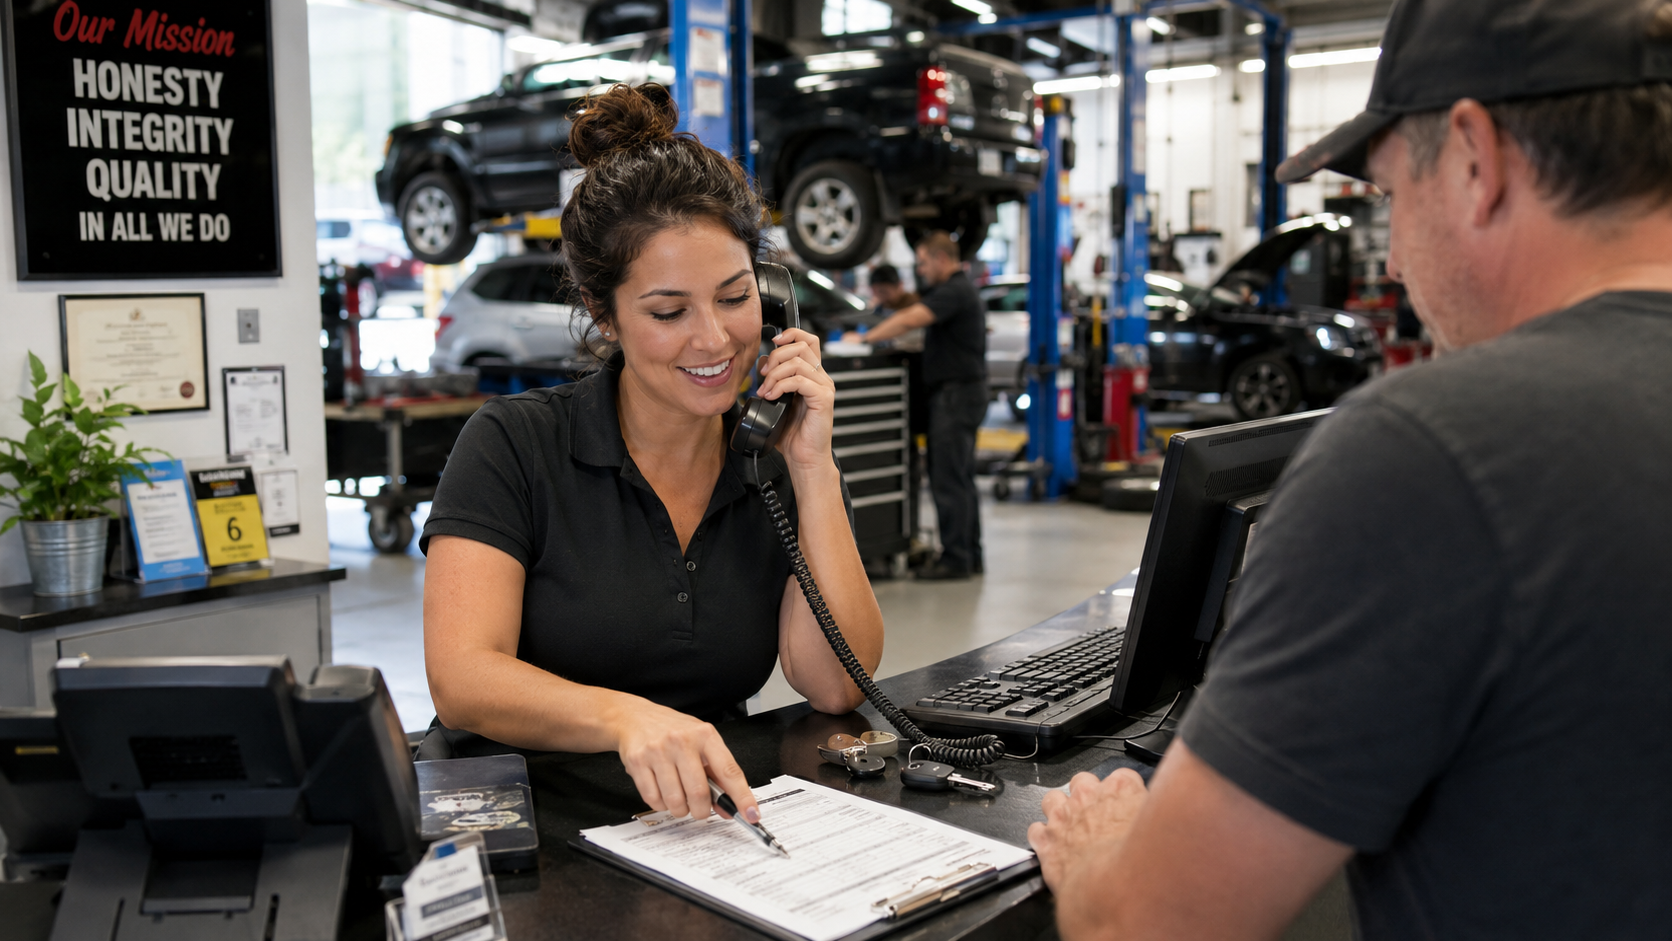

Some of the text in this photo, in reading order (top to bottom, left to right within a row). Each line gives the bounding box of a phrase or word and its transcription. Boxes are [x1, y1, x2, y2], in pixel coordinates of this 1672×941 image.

[53, 0, 235, 57] Our Mission
[73, 58, 223, 109] HONESTY
[66, 107, 234, 155] INTEGRITY
[86, 158, 221, 202] QUALITY
[79, 211, 230, 242] IN ALL WE DO
[227, 516, 242, 542] 6
